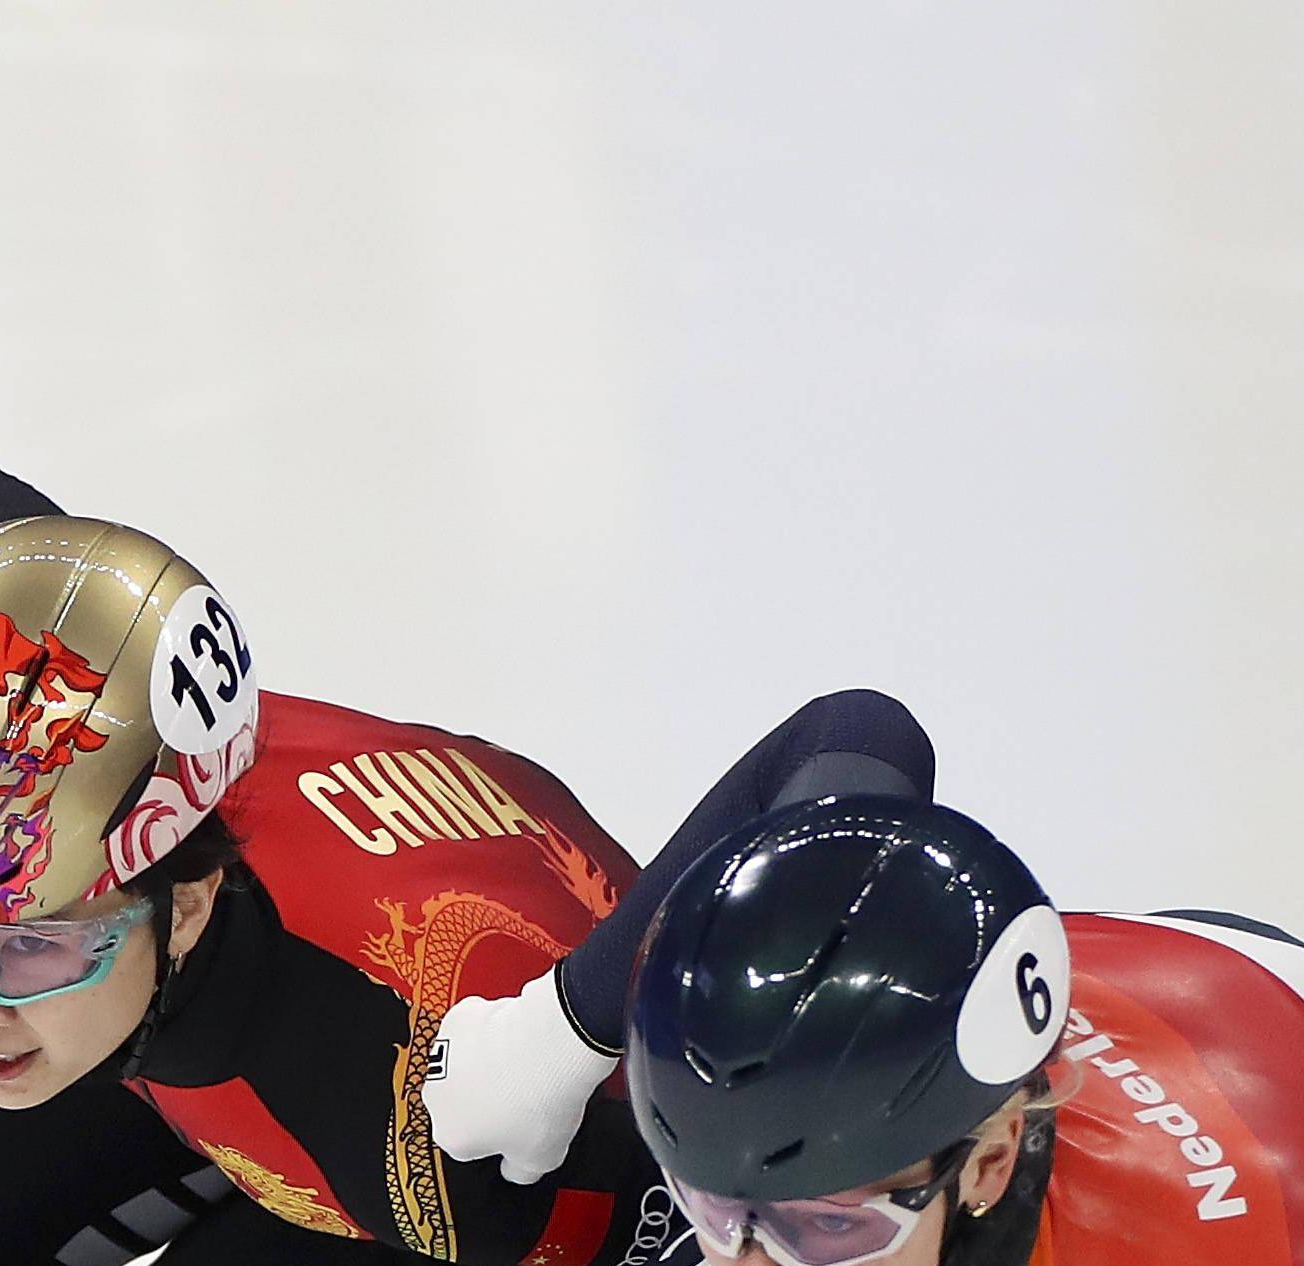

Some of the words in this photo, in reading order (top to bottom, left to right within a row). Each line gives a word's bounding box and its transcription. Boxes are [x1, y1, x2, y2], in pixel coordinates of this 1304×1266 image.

[169, 596, 252, 731] 132
[297, 747, 546, 856] CHINA
[1016, 952, 1051, 1035] 6
